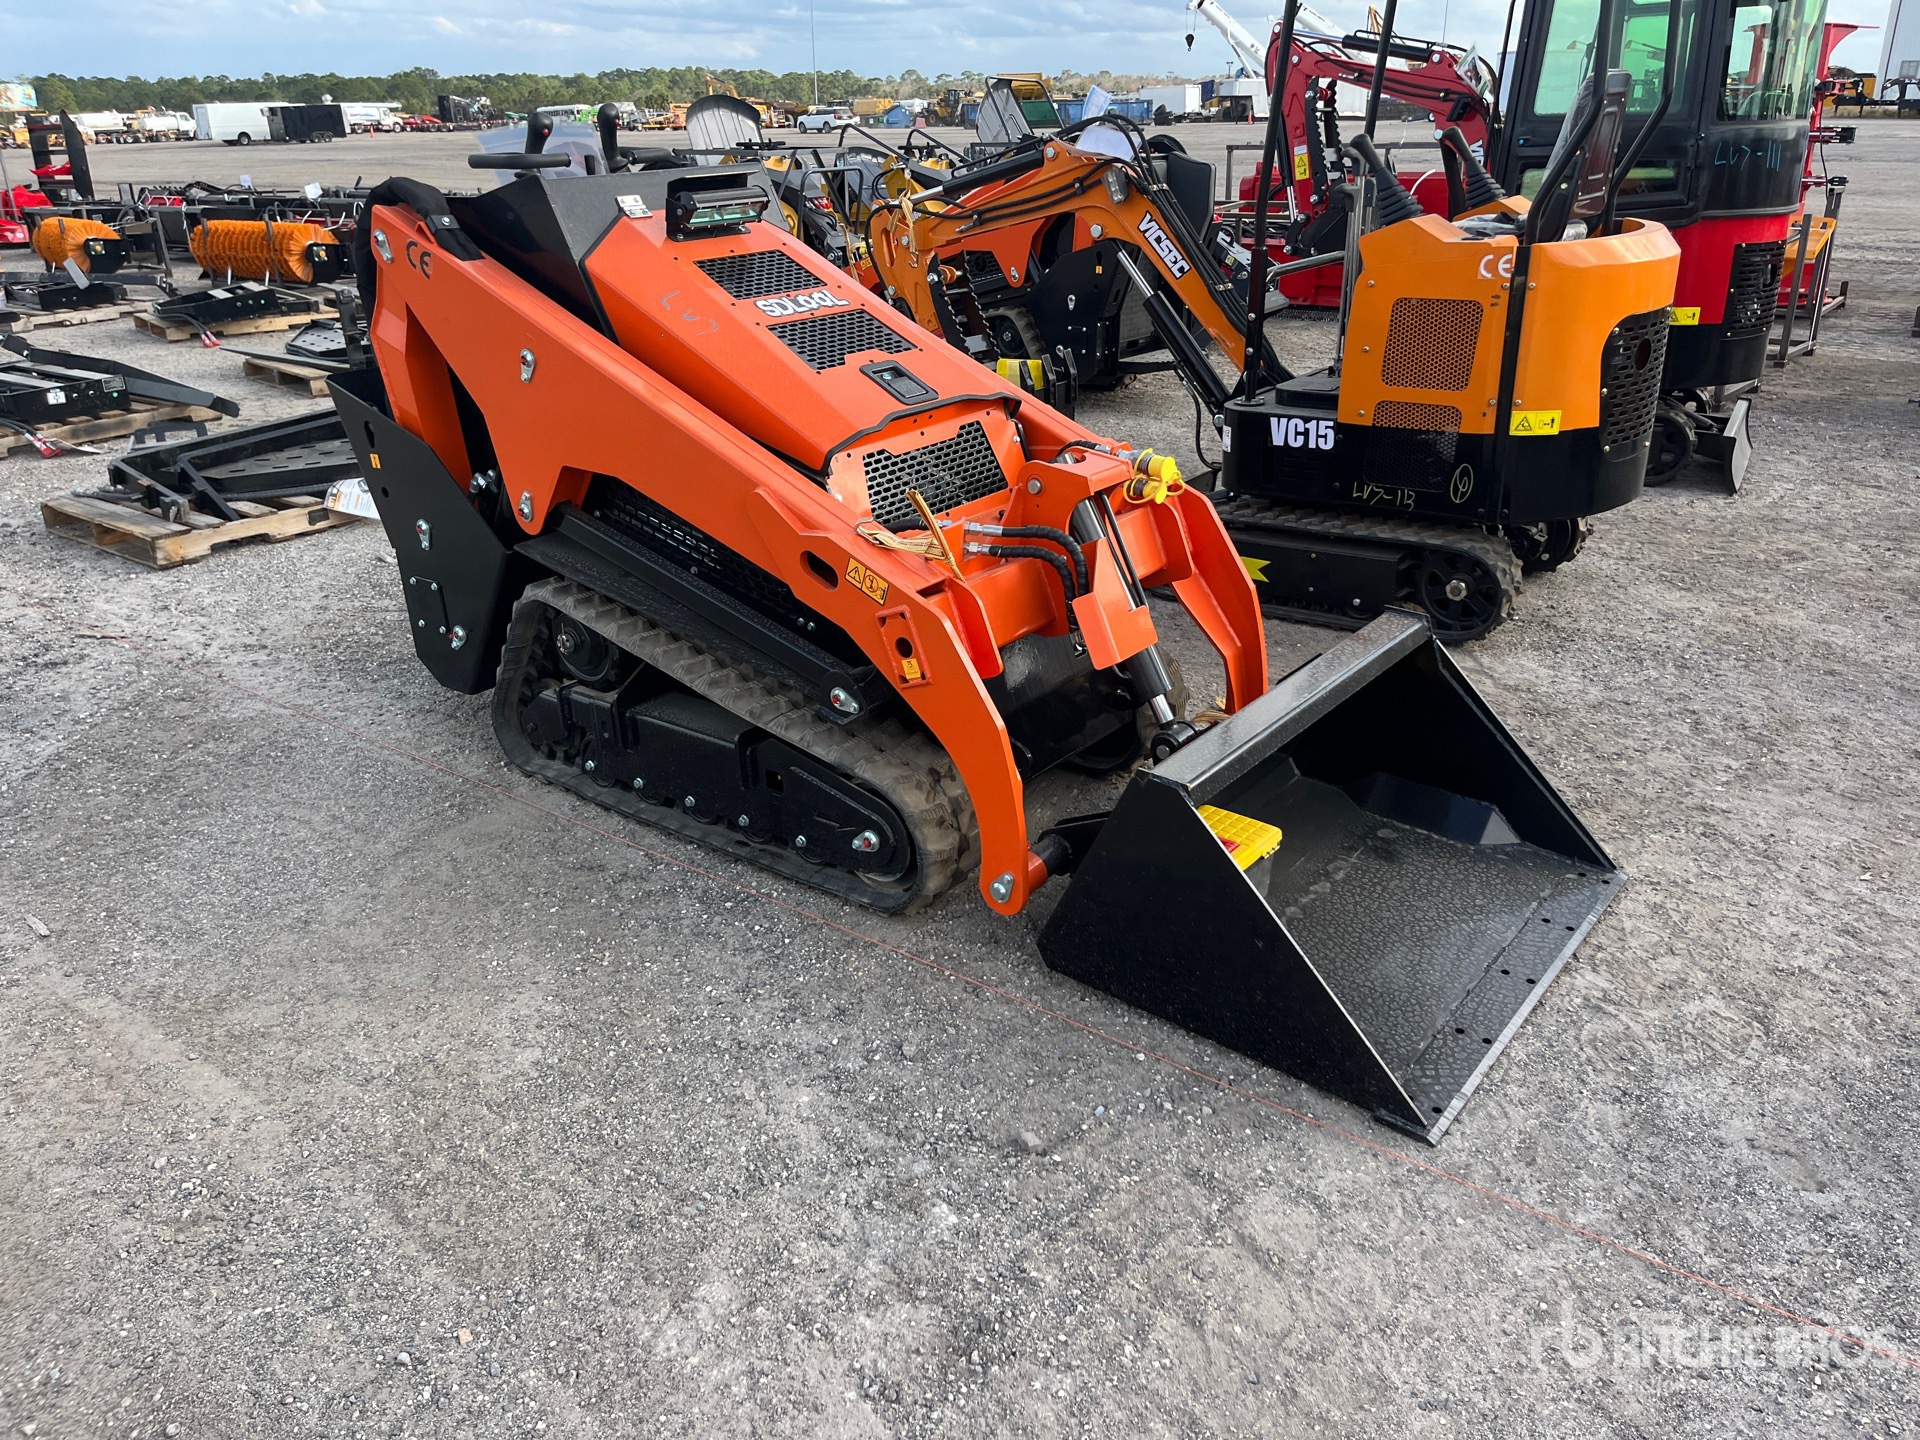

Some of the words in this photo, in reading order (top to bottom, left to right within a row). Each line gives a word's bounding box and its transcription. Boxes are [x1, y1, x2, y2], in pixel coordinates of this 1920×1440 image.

[406, 239, 432, 281] CE
[1137, 210, 1192, 280] VICSEC
[1480, 253, 1514, 278] CE
[1270, 416, 1335, 450] VC15
